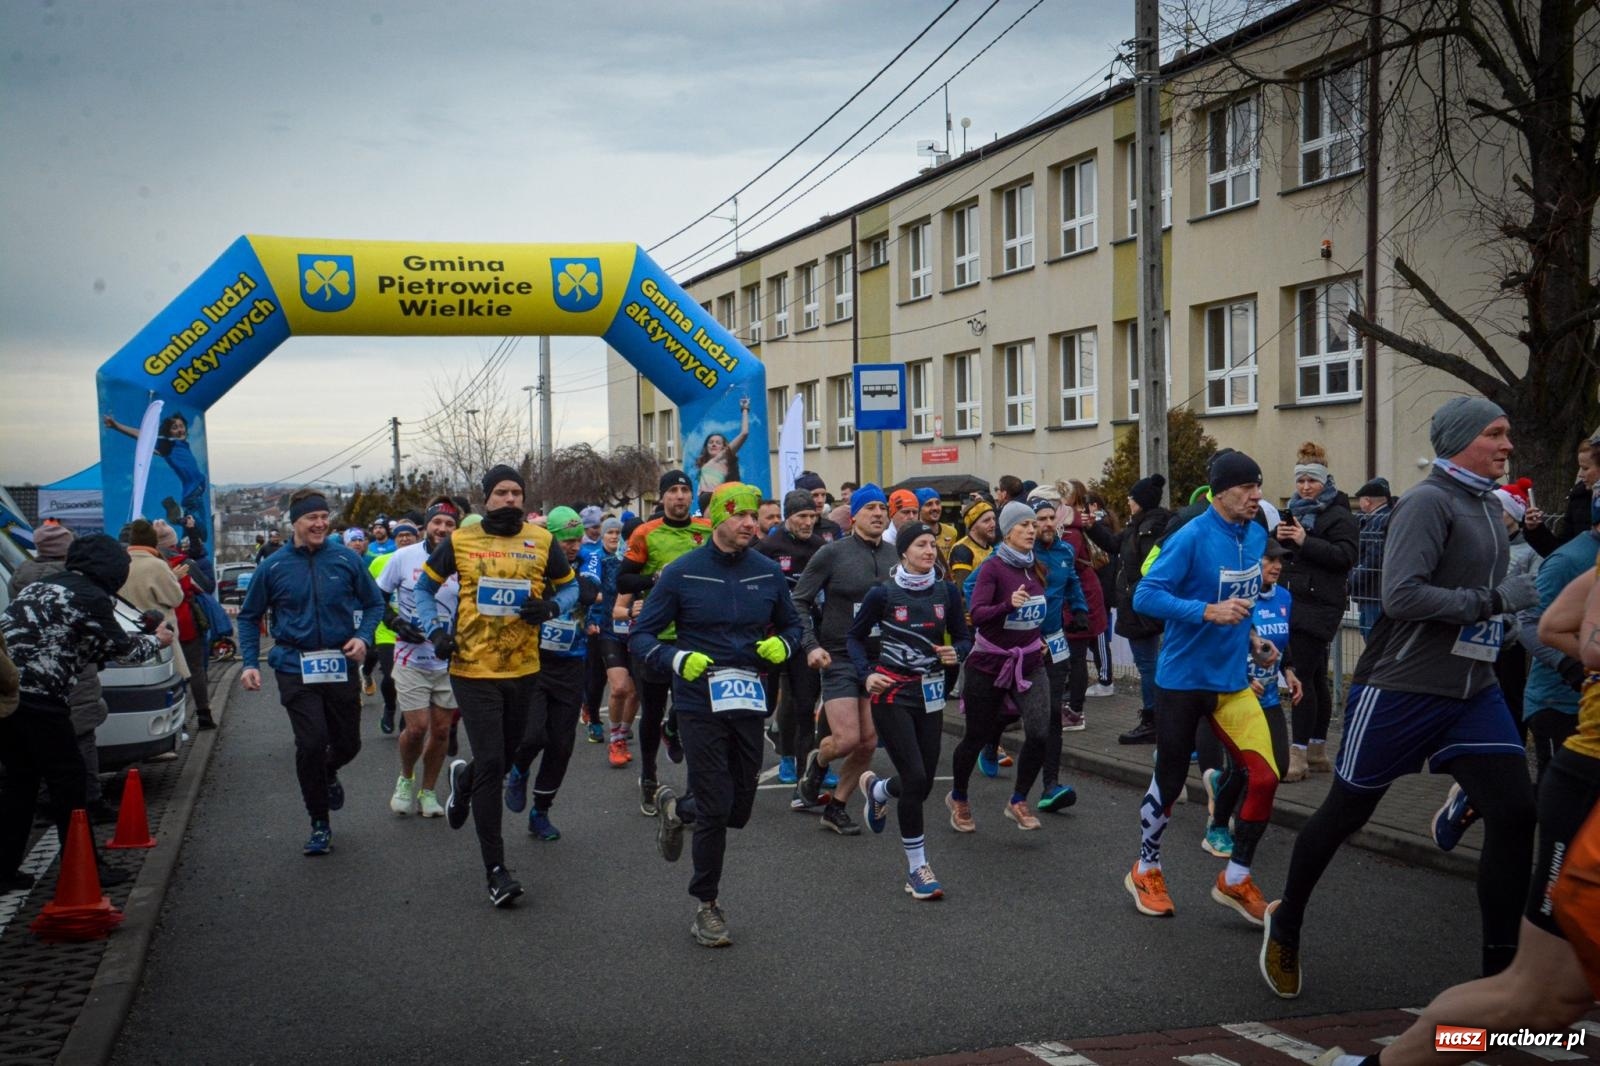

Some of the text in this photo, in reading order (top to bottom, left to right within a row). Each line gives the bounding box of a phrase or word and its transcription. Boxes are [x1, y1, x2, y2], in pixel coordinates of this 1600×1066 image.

[403, 255, 505, 272] Gmina
[378, 275, 533, 295] Pietrowice
[398, 299, 513, 317] Wielkie
[143, 272, 257, 375] Gmina ludzi
[640, 278, 740, 373] Gmina ludzi
[171, 297, 277, 395] aktywnych
[625, 301, 719, 389] aktywnych
[491, 589, 515, 605] 40
[1229, 578, 1258, 599] 216
[1016, 605, 1041, 621] 146
[541, 626, 563, 642] 52
[309, 659, 340, 673] 150
[720, 681, 757, 698] 204
